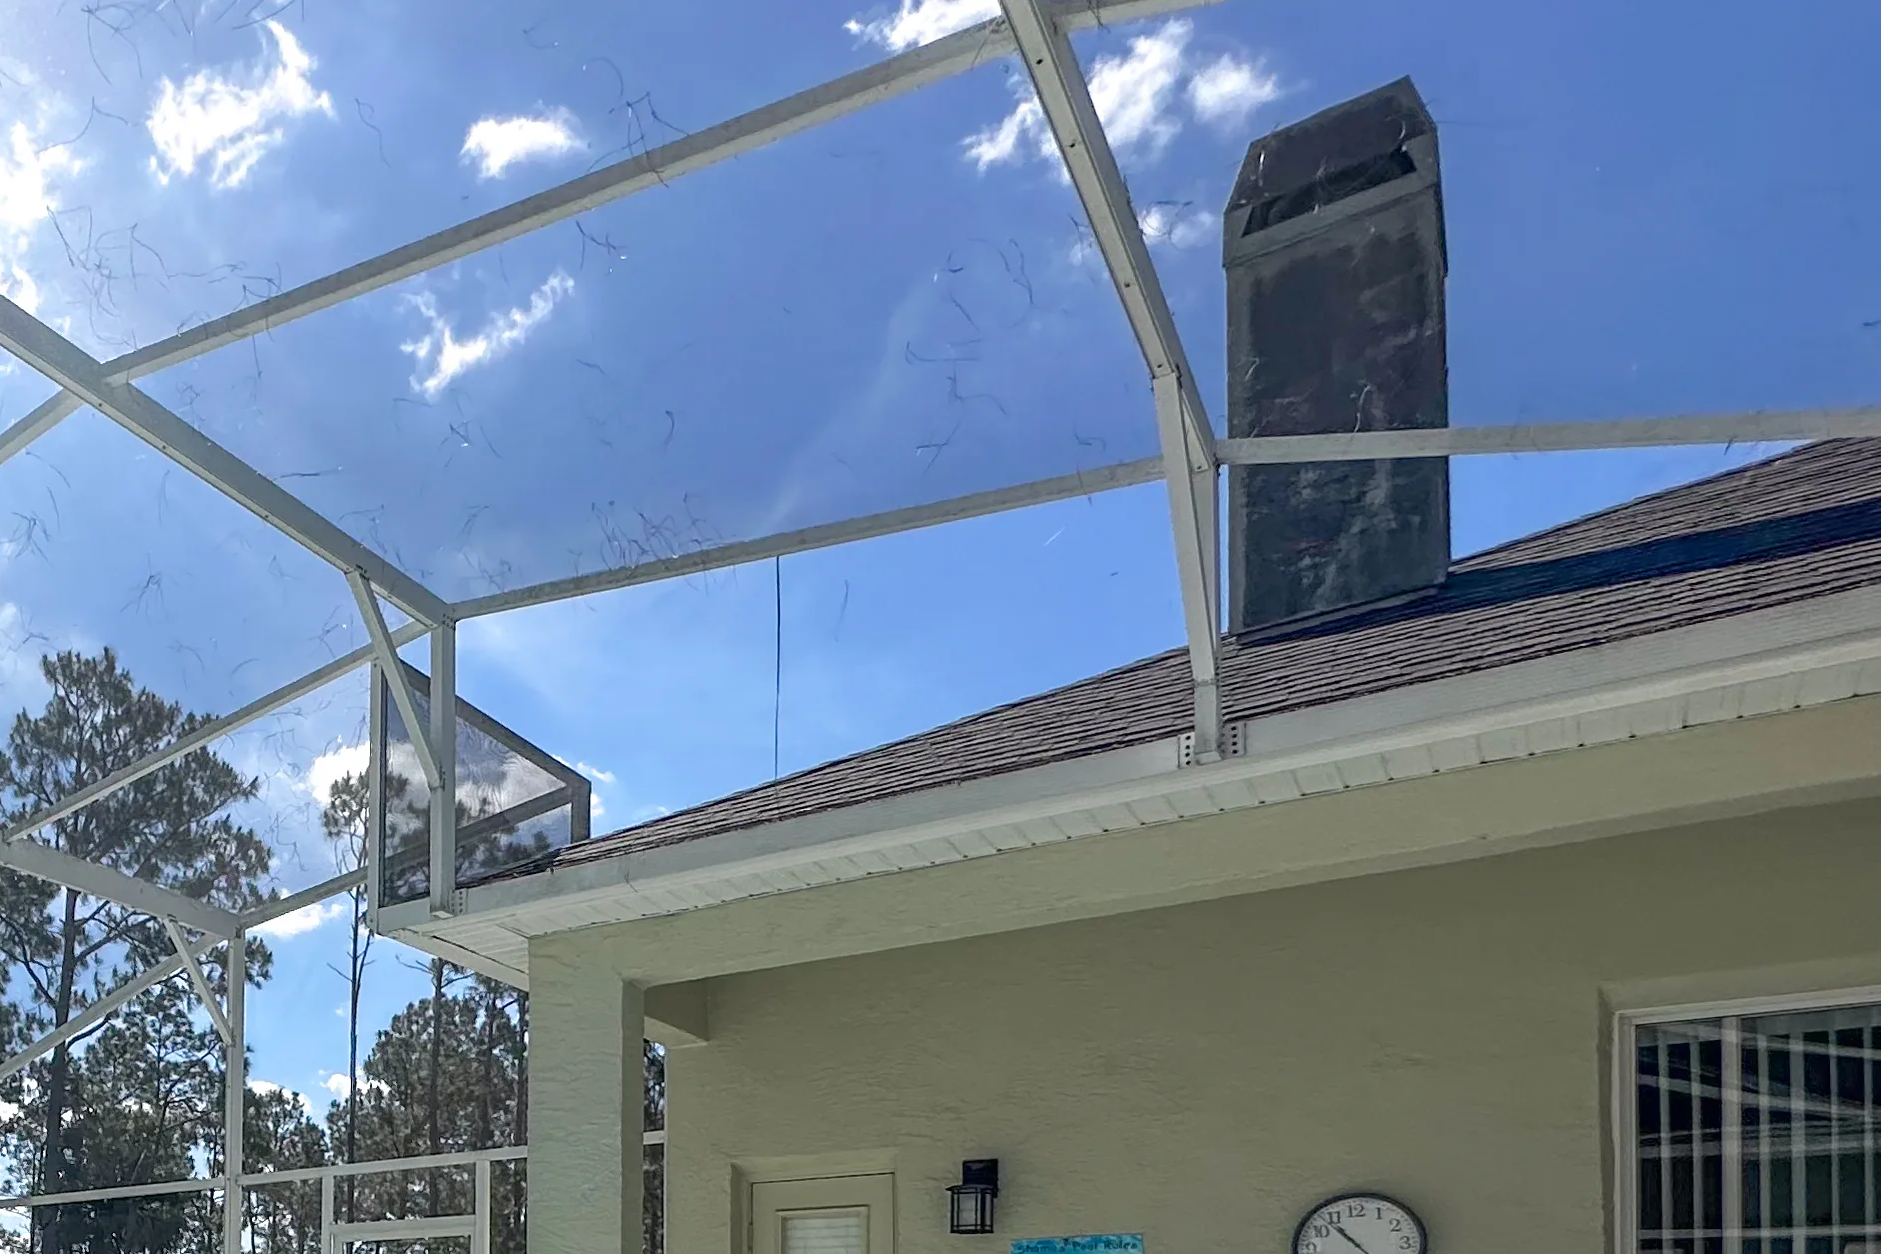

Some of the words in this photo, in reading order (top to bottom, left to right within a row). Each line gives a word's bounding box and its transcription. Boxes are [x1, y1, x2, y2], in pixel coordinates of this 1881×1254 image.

[1347, 1203, 1366, 1218] 12
[1375, 1207, 1383, 1220] 1
[1327, 1211, 1341, 1224] 11
[1313, 1224, 1330, 1238] 10
[1389, 1218, 1401, 1232] 2
[1072, 1241, 1098, 1251] Pool
[1103, 1239, 1138, 1250] Rules
[1305, 1242, 1317, 1254] 9
[1400, 1236, 1411, 1250] 3
